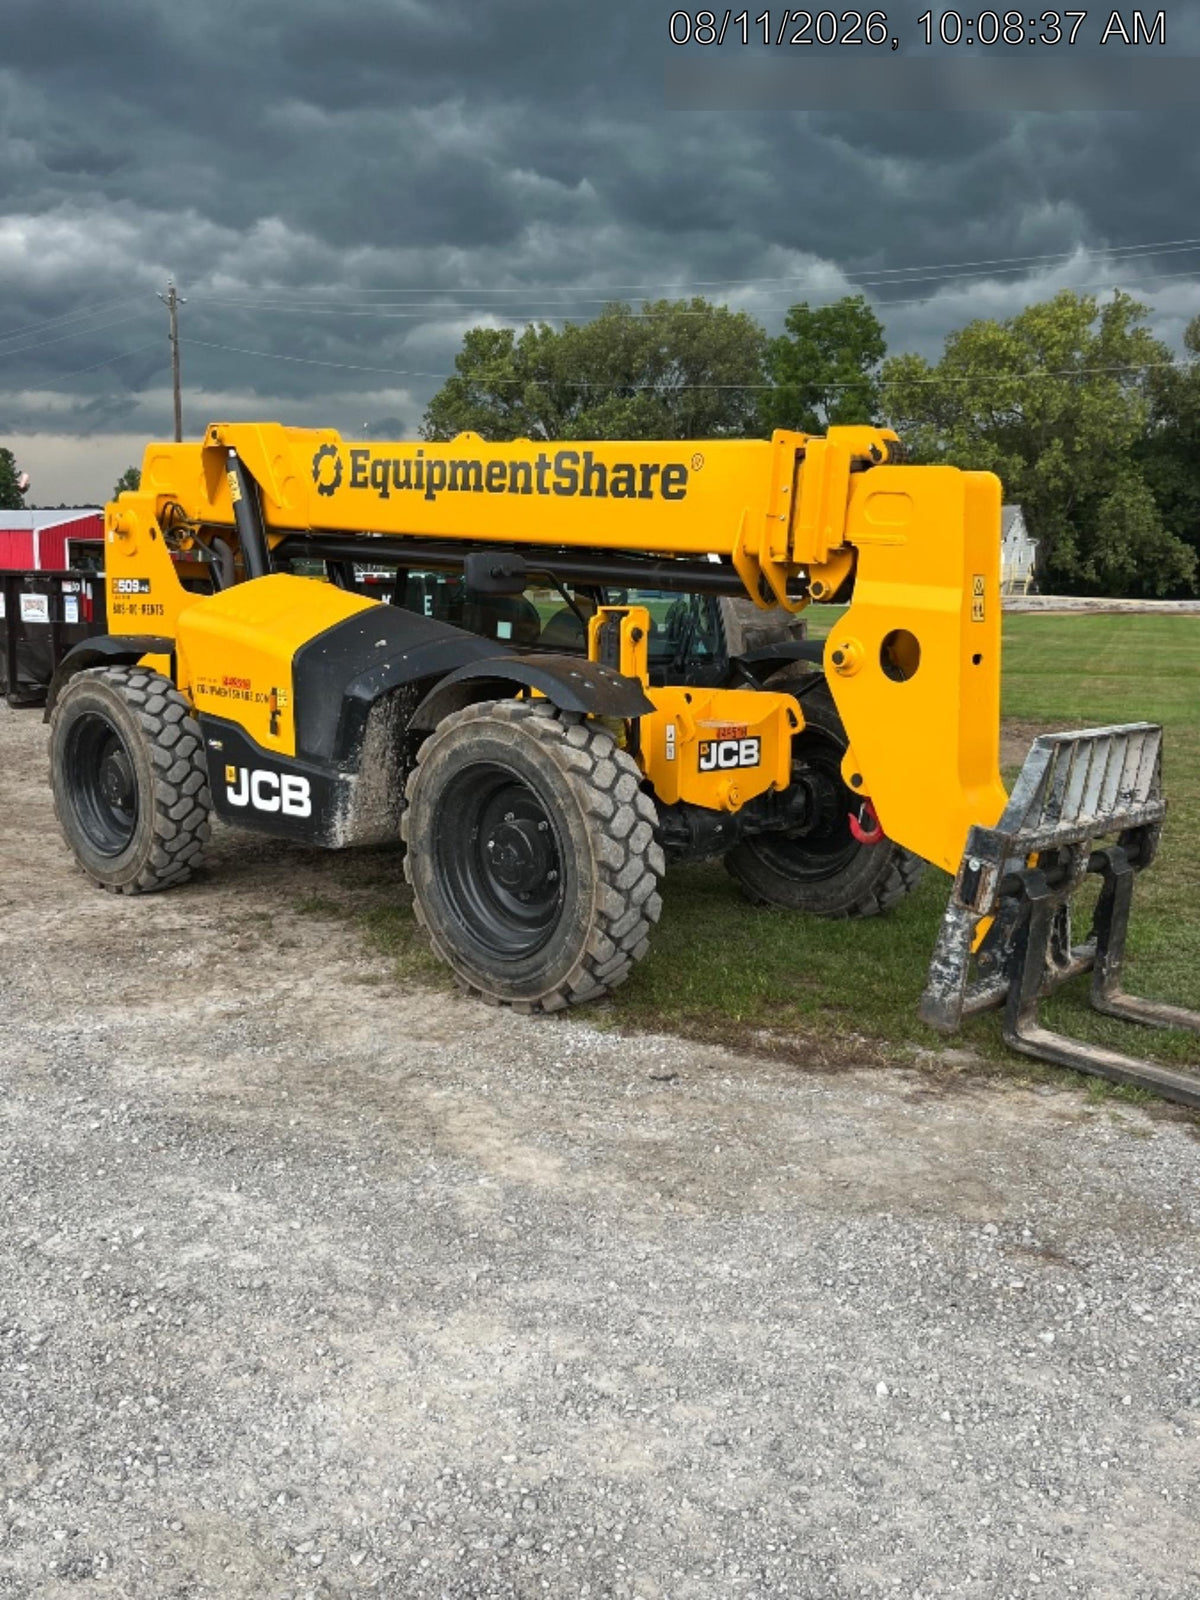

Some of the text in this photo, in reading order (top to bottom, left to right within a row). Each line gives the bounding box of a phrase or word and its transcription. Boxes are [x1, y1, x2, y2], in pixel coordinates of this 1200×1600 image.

[349, 449, 689, 502] EquipmentShare
[700, 739, 760, 771] JCB
[226, 766, 312, 819] JCB
